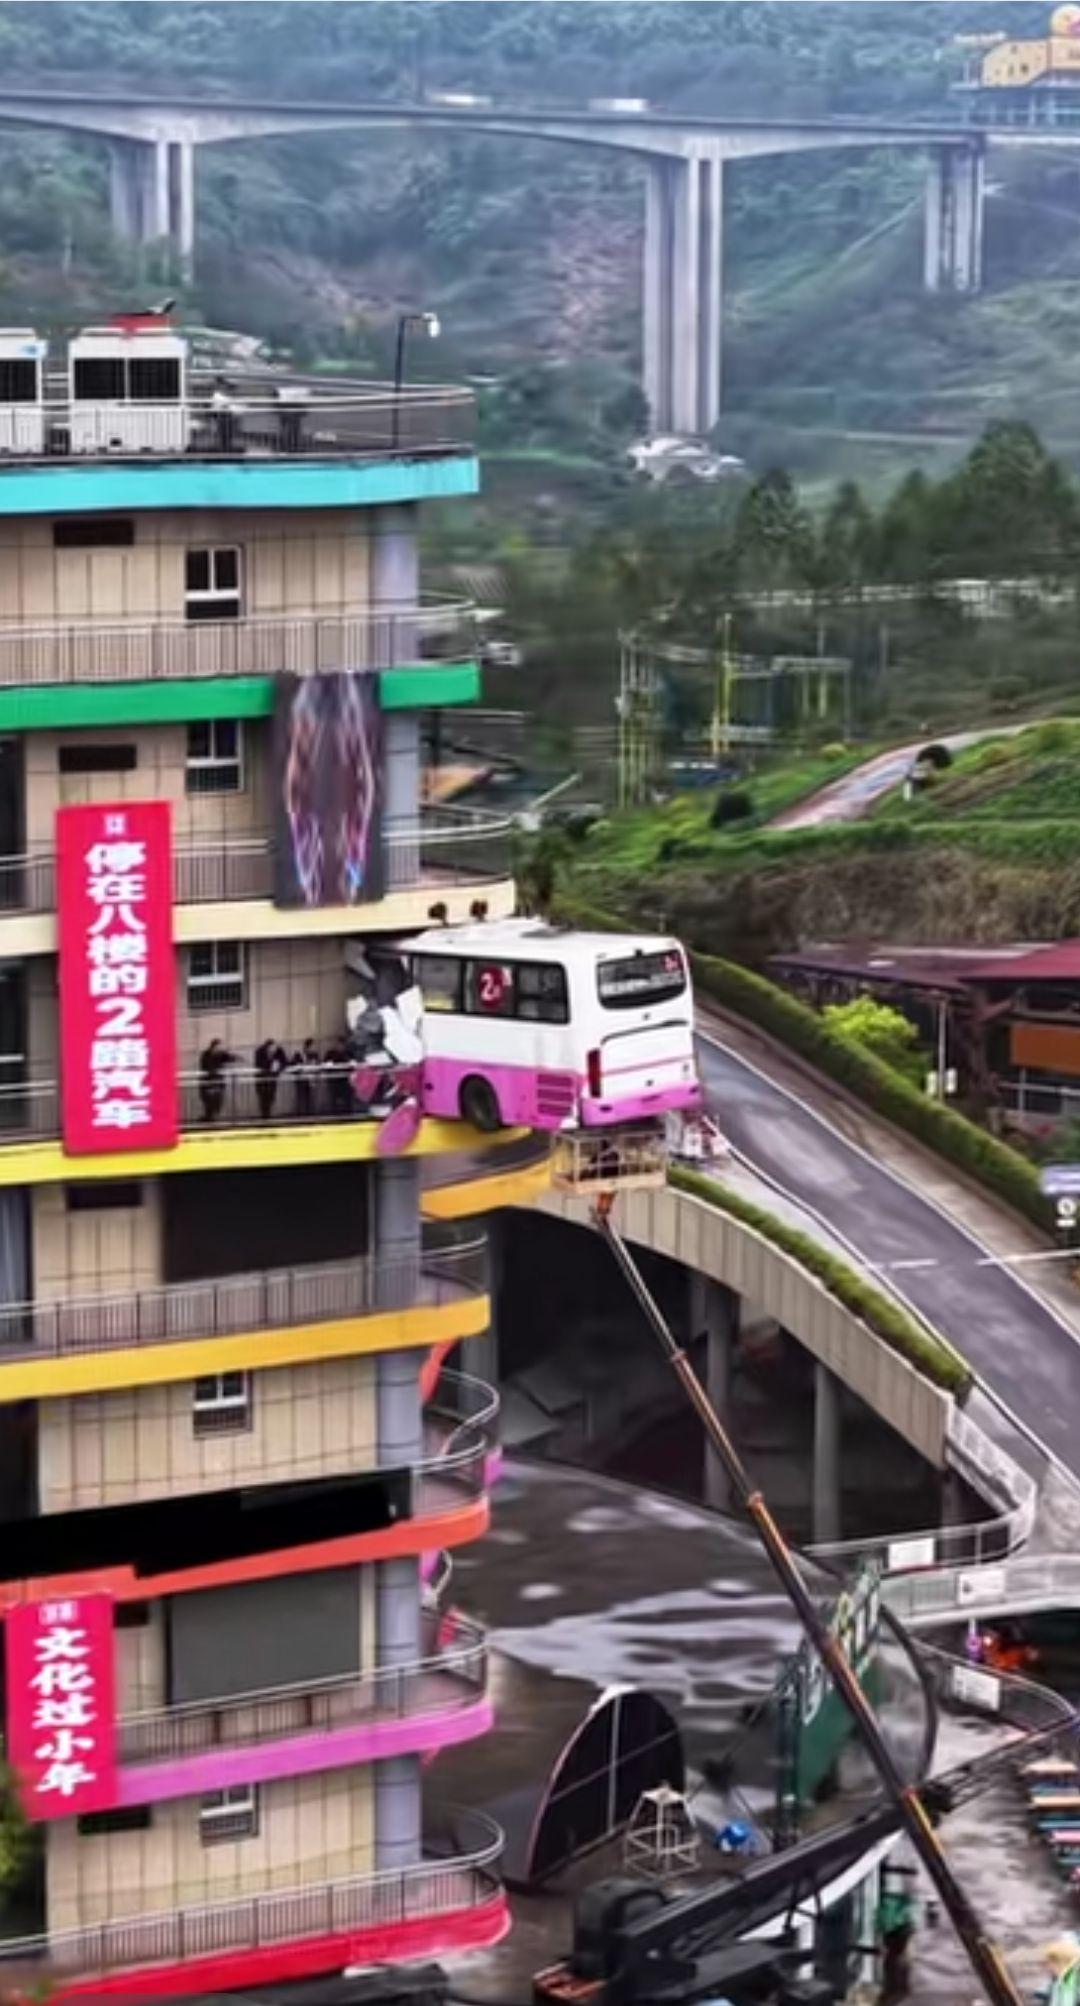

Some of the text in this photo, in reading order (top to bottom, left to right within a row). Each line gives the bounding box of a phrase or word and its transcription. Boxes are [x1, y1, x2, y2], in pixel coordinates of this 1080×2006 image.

[85, 842, 151, 1128] 停在八楼的2路汽车
[29, 1627, 96, 1796] 文化过小年
